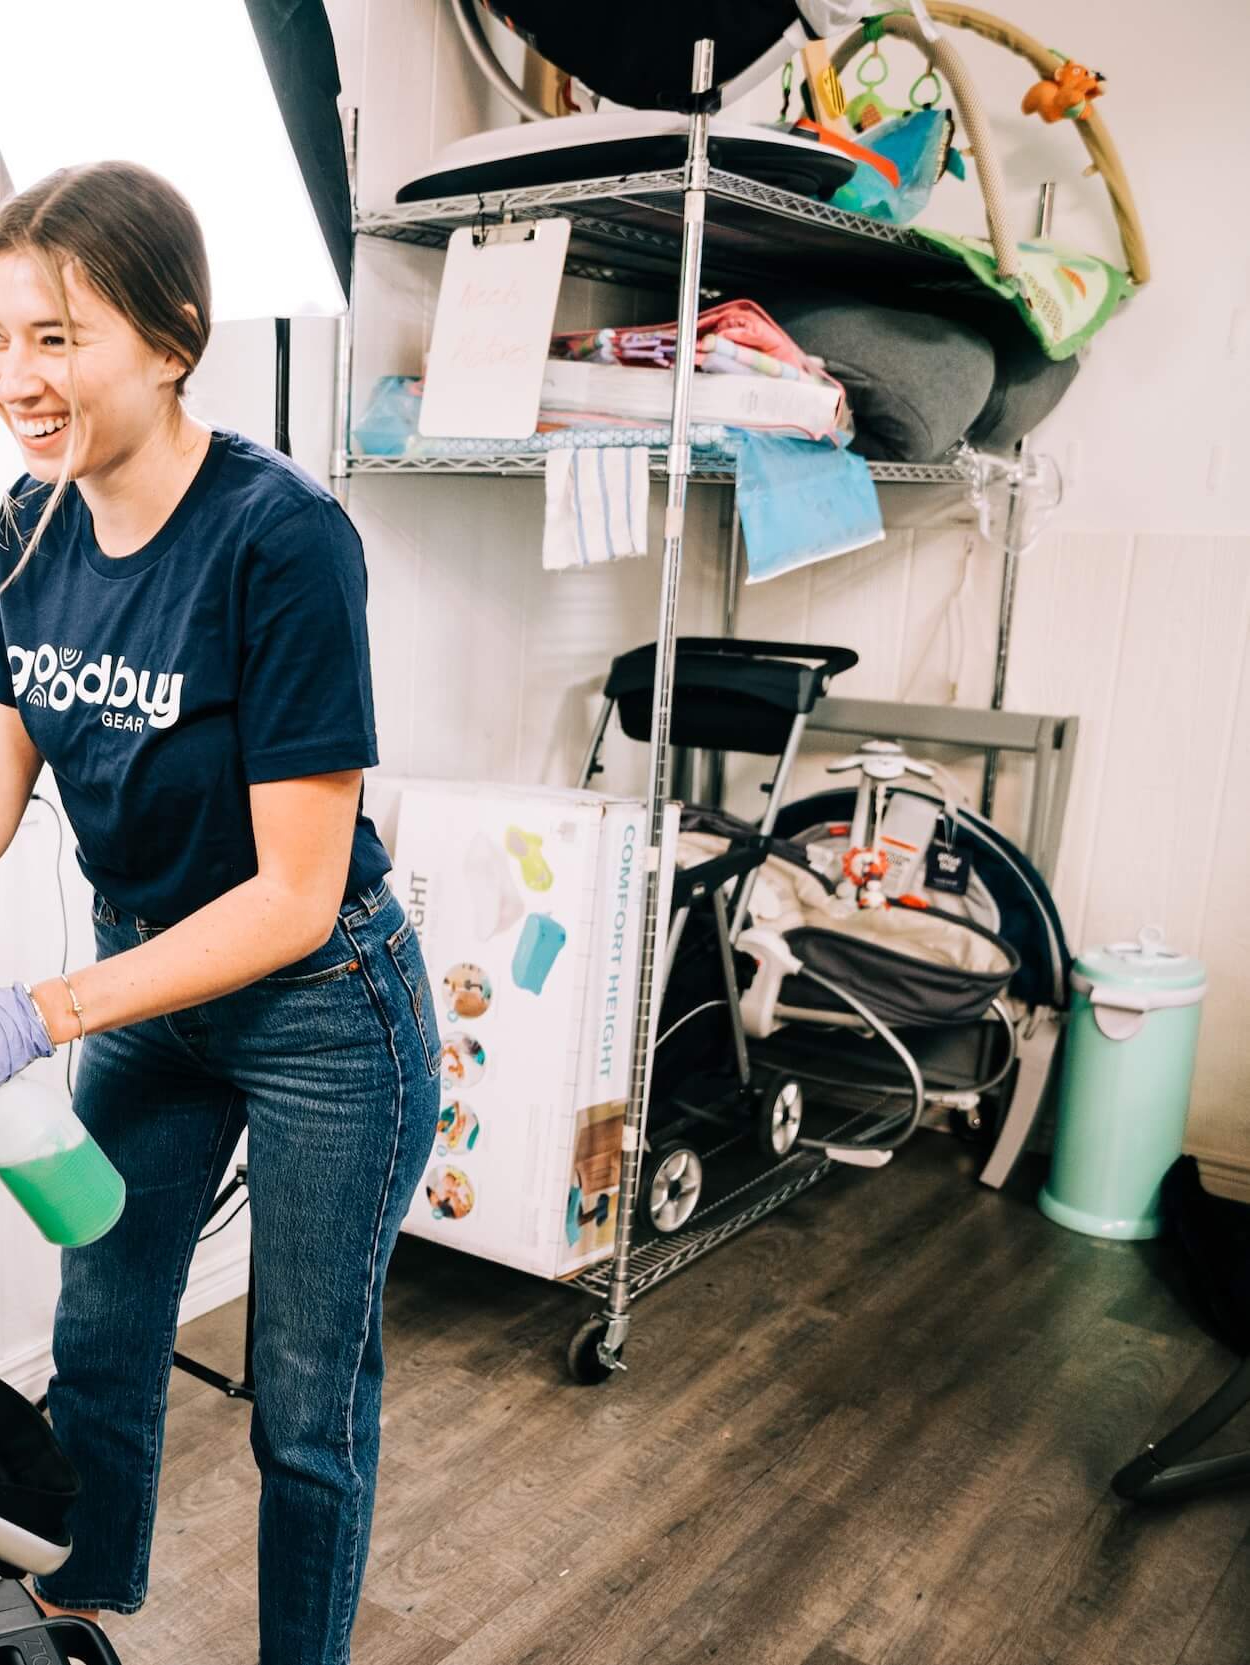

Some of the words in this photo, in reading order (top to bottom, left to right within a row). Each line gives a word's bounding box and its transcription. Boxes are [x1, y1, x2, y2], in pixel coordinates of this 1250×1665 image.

[7, 643, 184, 729] goodbuy
[101, 711, 145, 733] GEAR
[610, 823, 636, 965] COMFORT
[598, 974, 620, 1079] HEIGHT
